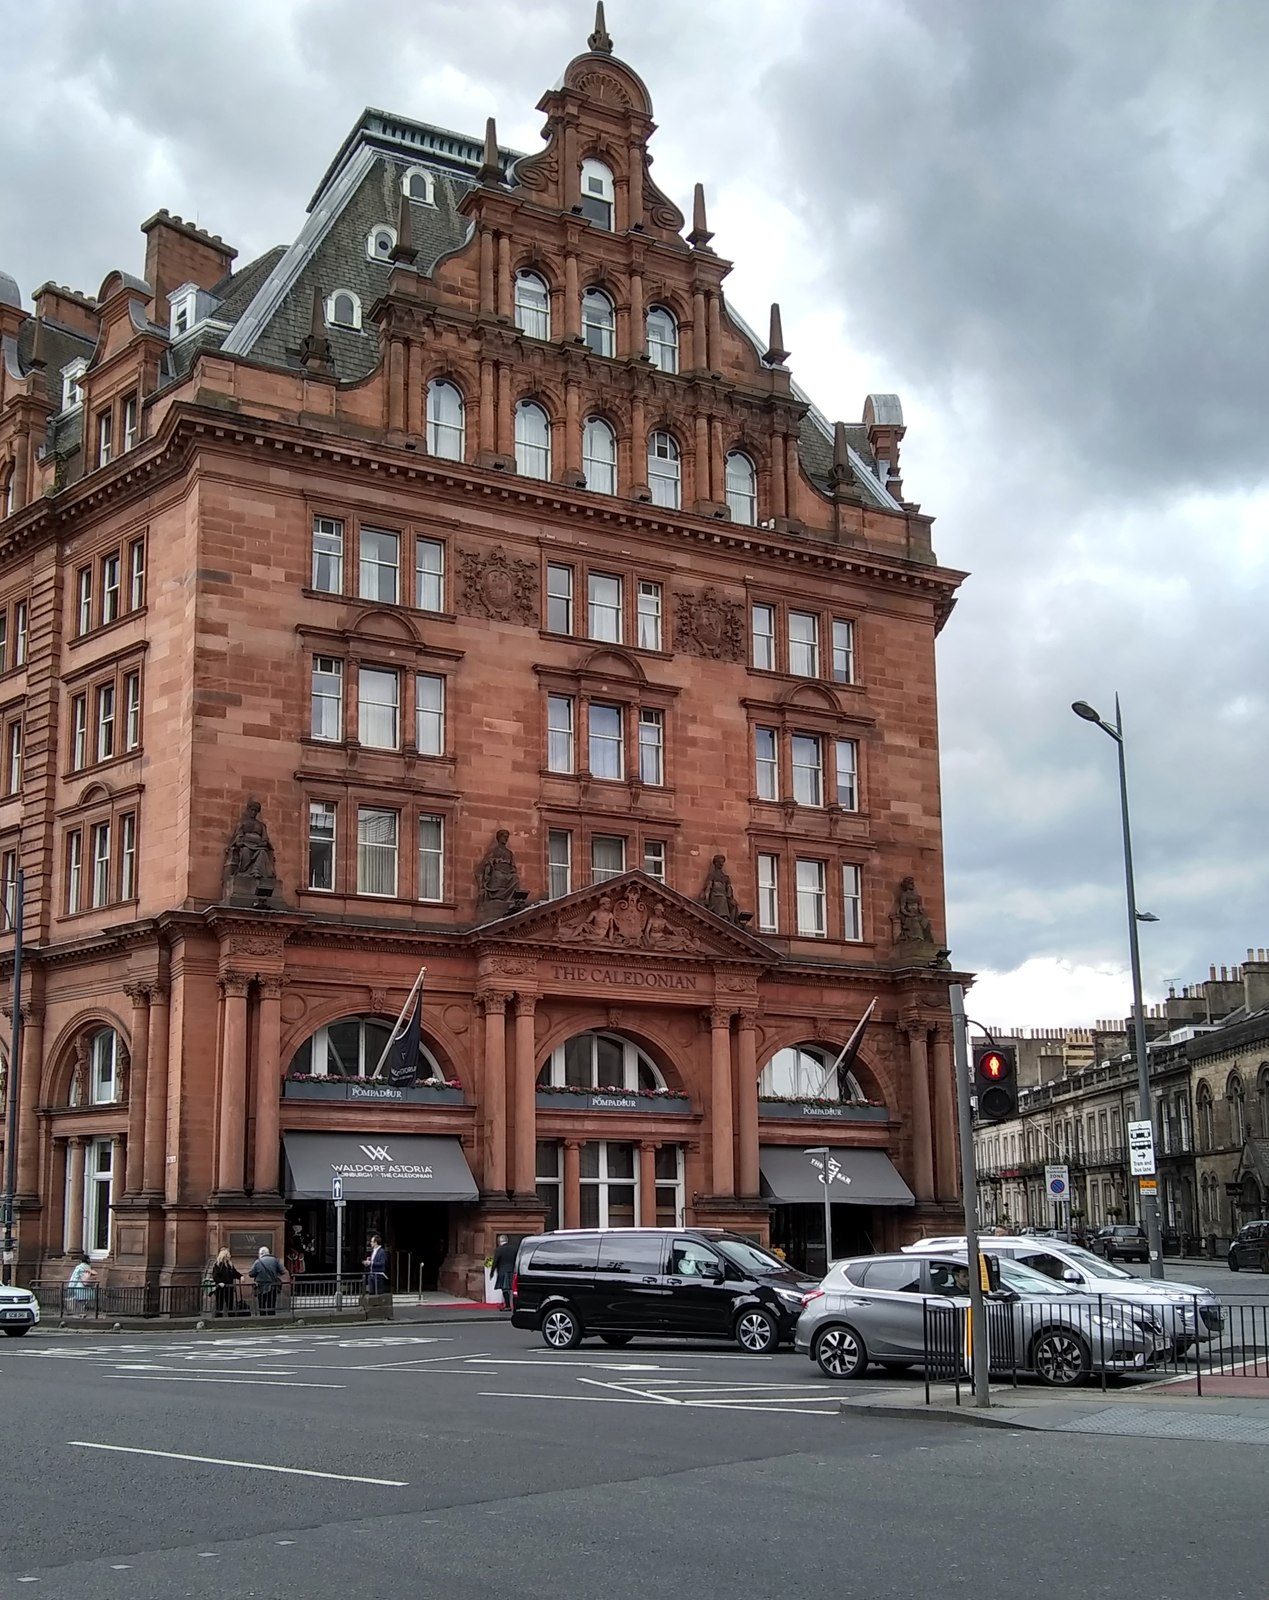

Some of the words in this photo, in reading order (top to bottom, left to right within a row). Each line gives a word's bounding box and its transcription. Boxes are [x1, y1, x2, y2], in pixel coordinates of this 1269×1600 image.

[551, 965, 587, 981] THE
[590, 968, 697, 989] CALEDONIAN
[331, 1163, 386, 1172] WALDORF
[388, 1165, 432, 1173] ASTORIA
[836, 1172, 852, 1184] BAR
